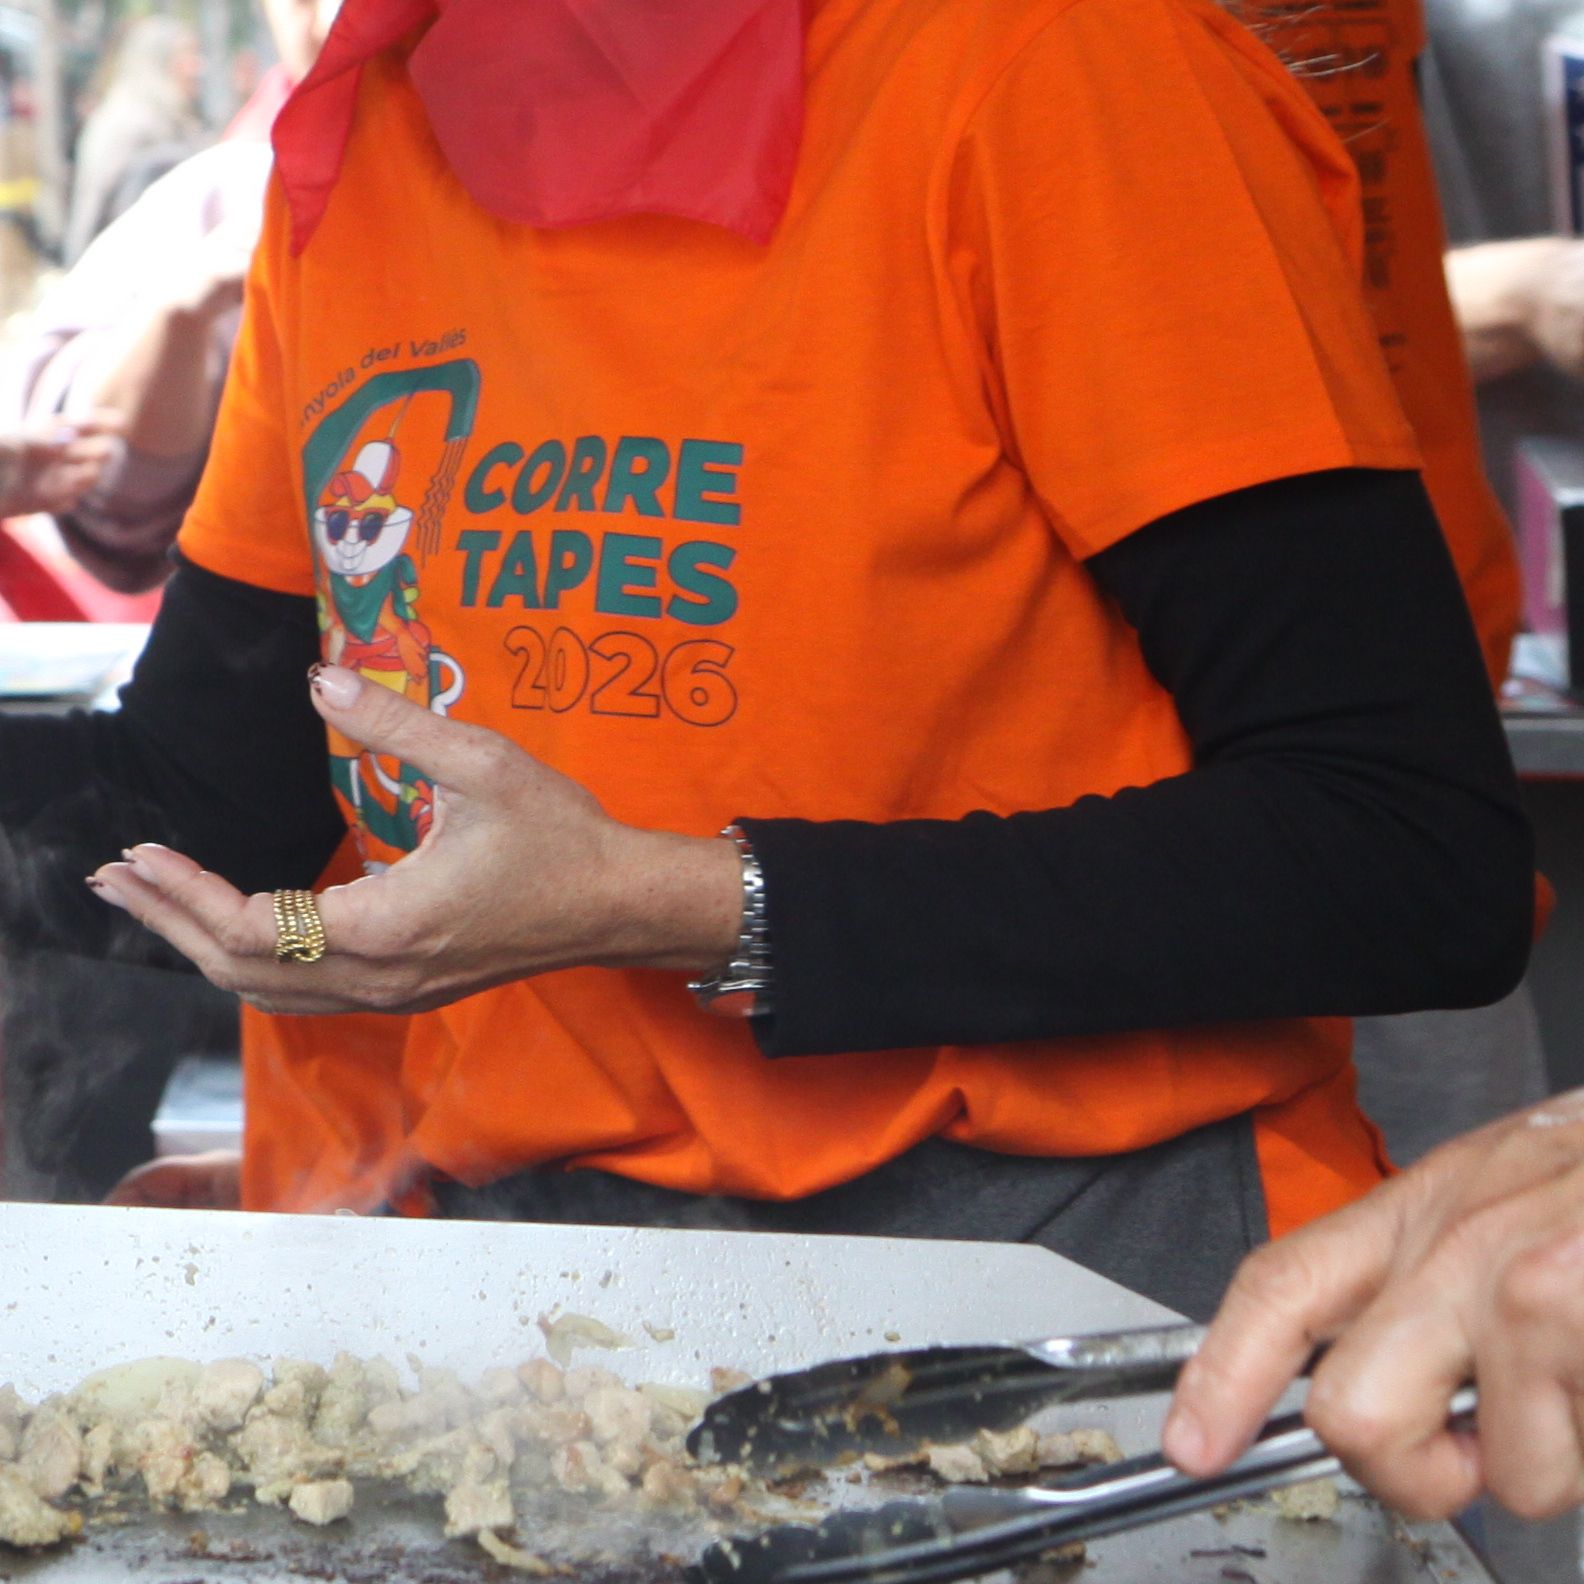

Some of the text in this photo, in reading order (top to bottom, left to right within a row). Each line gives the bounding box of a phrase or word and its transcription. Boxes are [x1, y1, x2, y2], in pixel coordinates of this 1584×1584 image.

[359, 341, 402, 369] del
[464, 435, 743, 526] CORRE
[455, 529, 739, 627] TAPES
[503, 625, 738, 728] 2026
